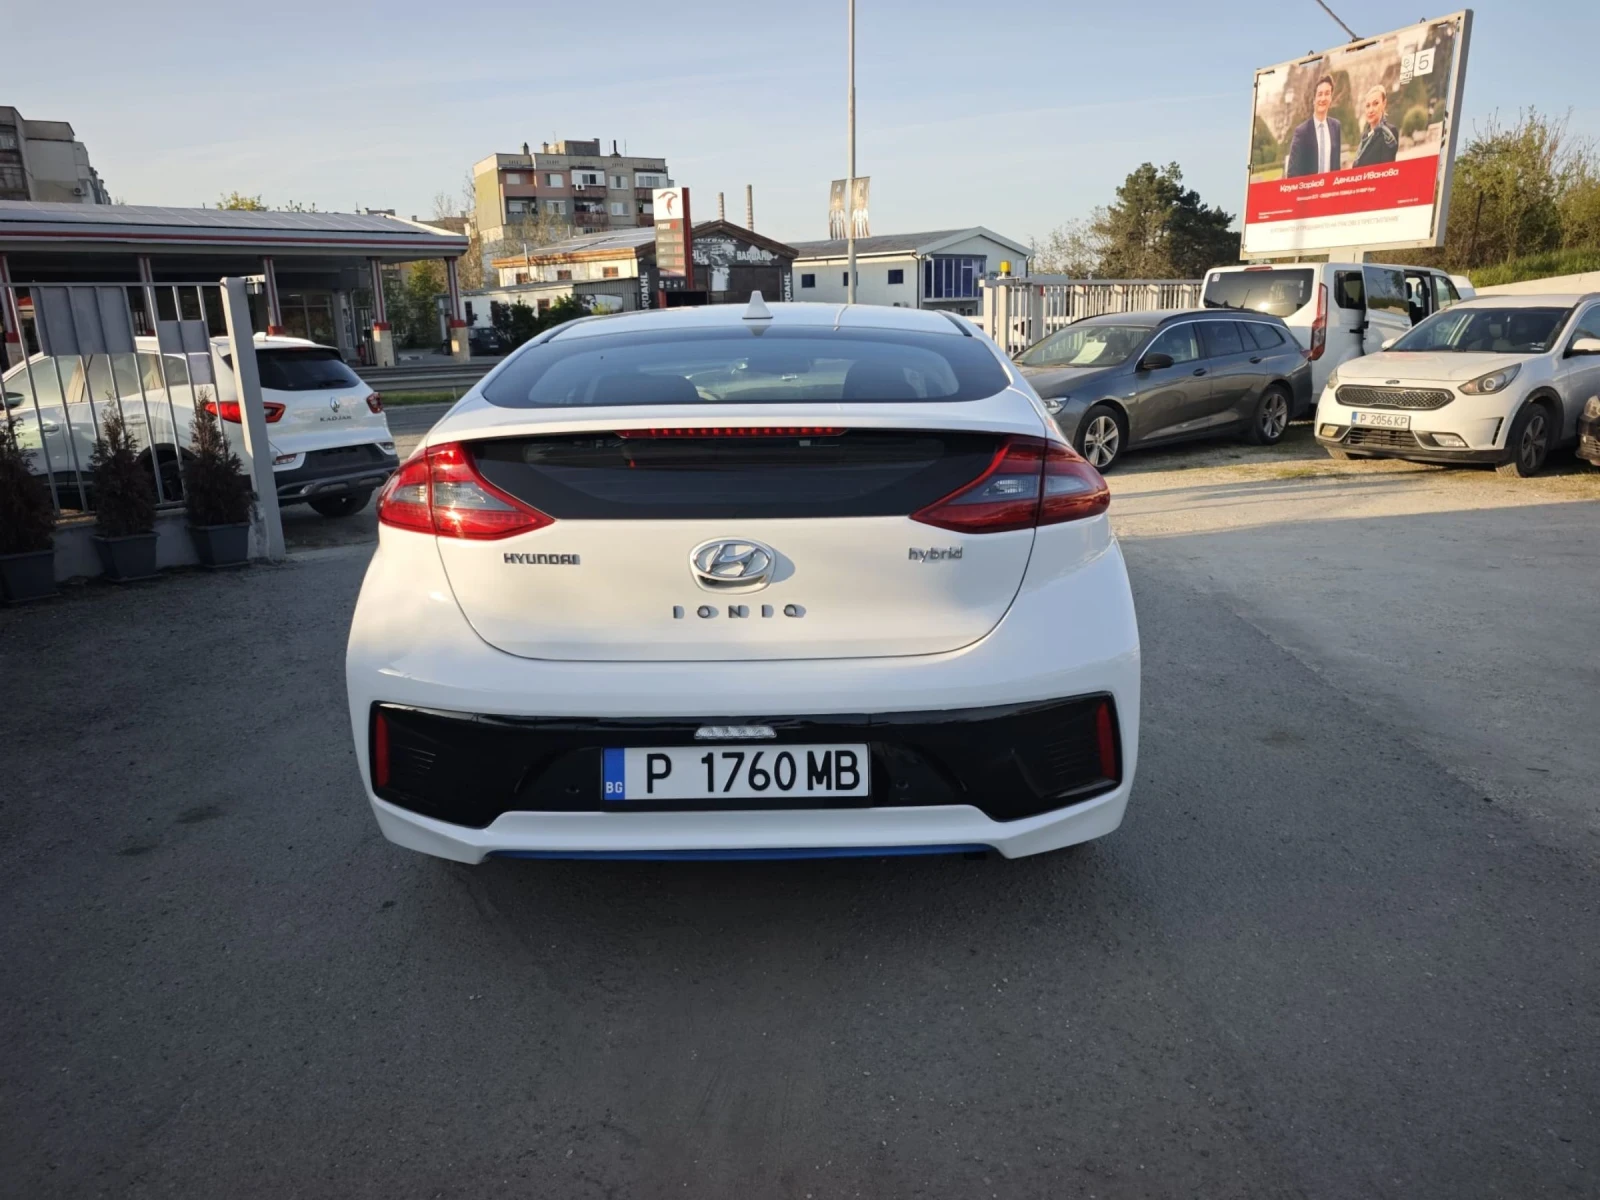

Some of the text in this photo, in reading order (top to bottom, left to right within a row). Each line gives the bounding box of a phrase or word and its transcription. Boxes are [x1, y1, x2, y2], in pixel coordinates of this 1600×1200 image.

[1418, 54, 1429, 71] 5
[1370, 415, 1393, 426] 2056
[1394, 416, 1408, 427] KP
[503, 553, 580, 566] HYUNDAI
[908, 545, 963, 563] hybrid
[672, 603, 804, 619] IONIQ
[646, 749, 861, 794] P 1760 MB
[605, 781, 623, 794] BG
